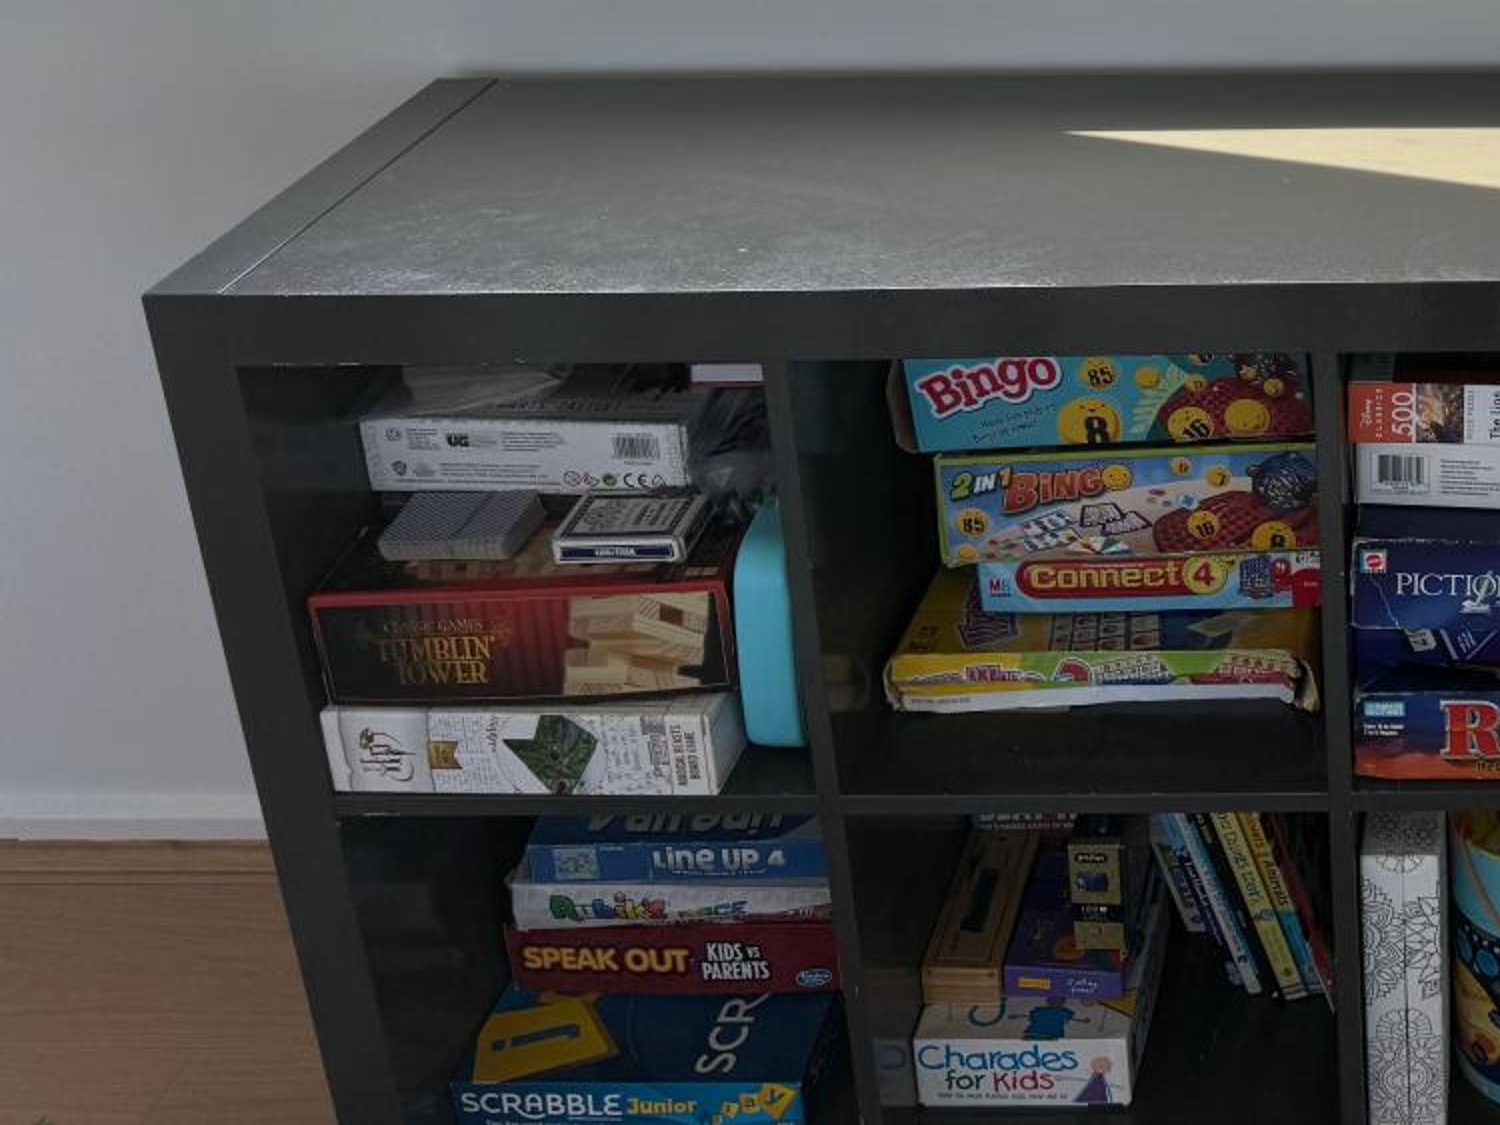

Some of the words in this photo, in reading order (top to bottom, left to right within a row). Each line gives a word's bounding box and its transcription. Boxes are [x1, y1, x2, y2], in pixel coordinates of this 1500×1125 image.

[920, 357, 1058, 416] Bingo
[1087, 366, 1114, 387] 85
[1391, 391, 1415, 439] 500
[951, 476, 974, 501] 2
[973, 473, 996, 494] IN
[1029, 564, 1180, 591] Connect
[1188, 563, 1215, 586] 4
[398, 661, 489, 685] TOWER
[766, 849, 789, 867] 4
[522, 946, 618, 972] SPEAK
[625, 946, 691, 973] OUT
[706, 942, 743, 963] KIDS
[702, 960, 772, 981] PARENTS
[918, 1042, 1080, 1072] Charades
[945, 1070, 987, 1091] for
[992, 1070, 1056, 1092] Kids
[462, 1091, 625, 1120] SCRABBLE
[627, 1095, 698, 1116] Junior
